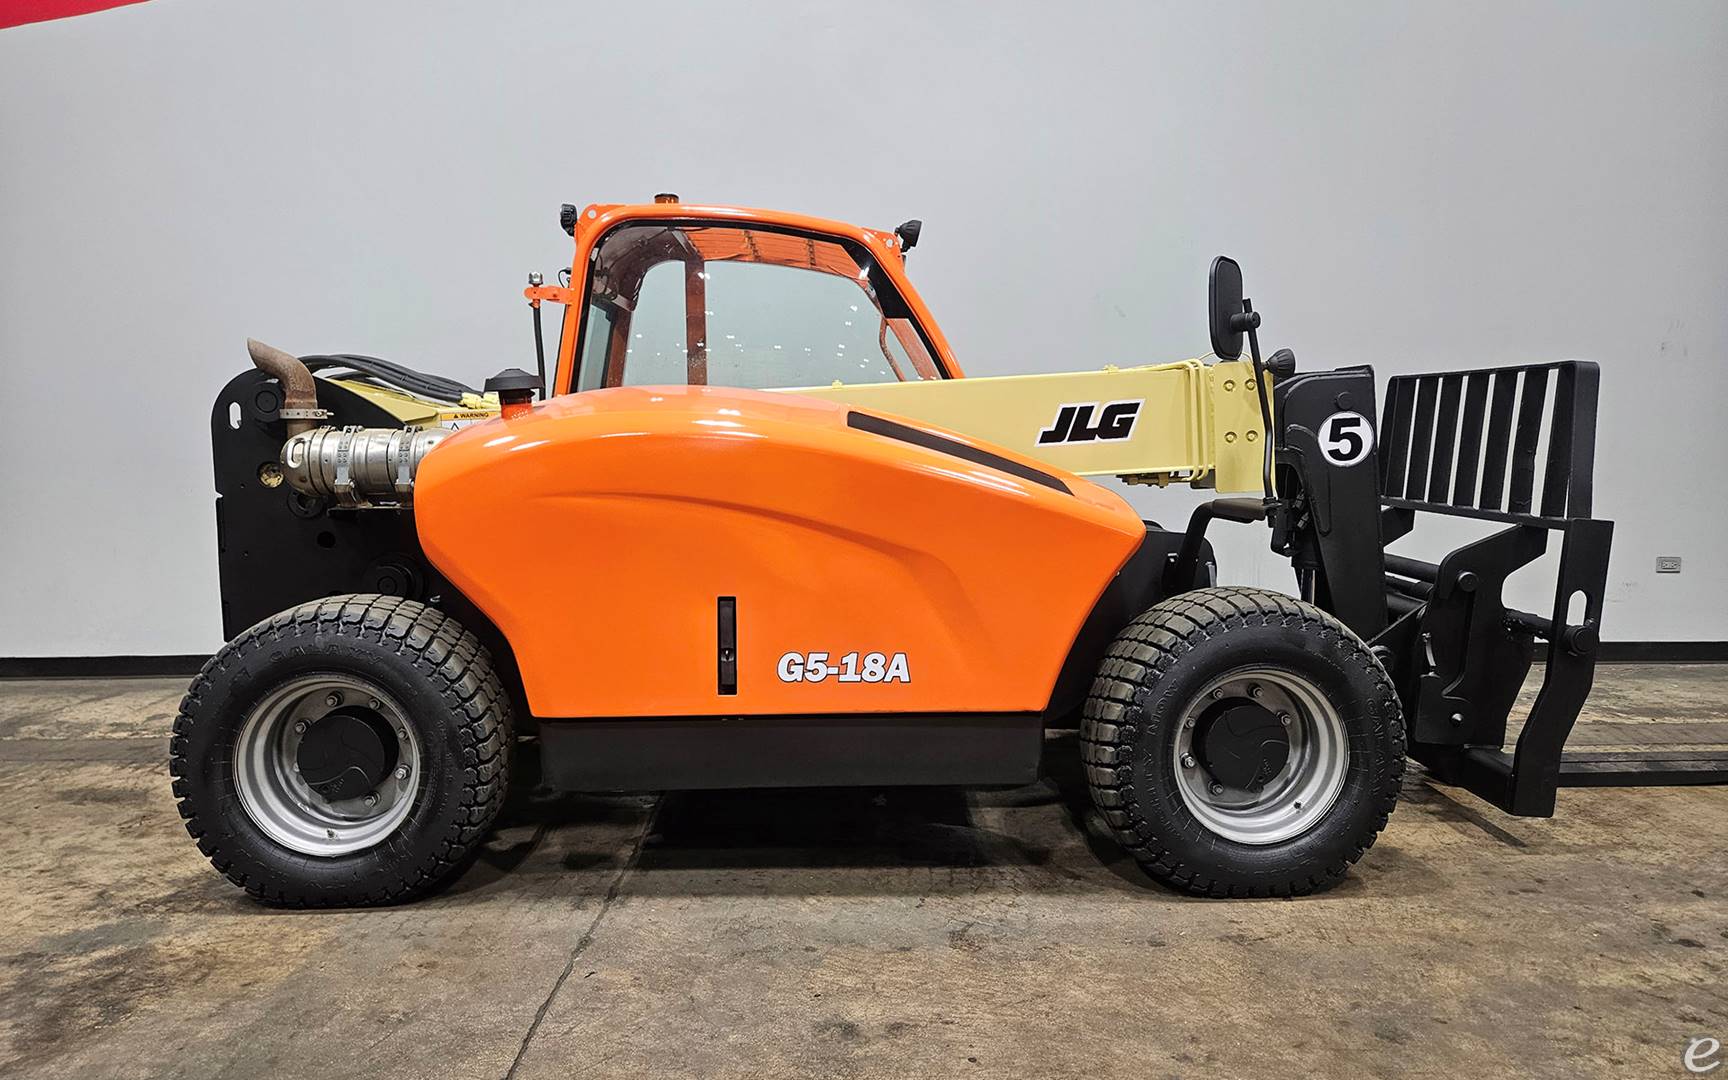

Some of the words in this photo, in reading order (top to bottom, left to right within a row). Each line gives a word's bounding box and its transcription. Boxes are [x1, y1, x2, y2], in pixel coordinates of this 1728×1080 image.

[460, 411, 489, 419] WARNING
[1038, 401, 1141, 444] JLG
[1326, 416, 1364, 462] 5
[777, 651, 911, 683] G5-18A
